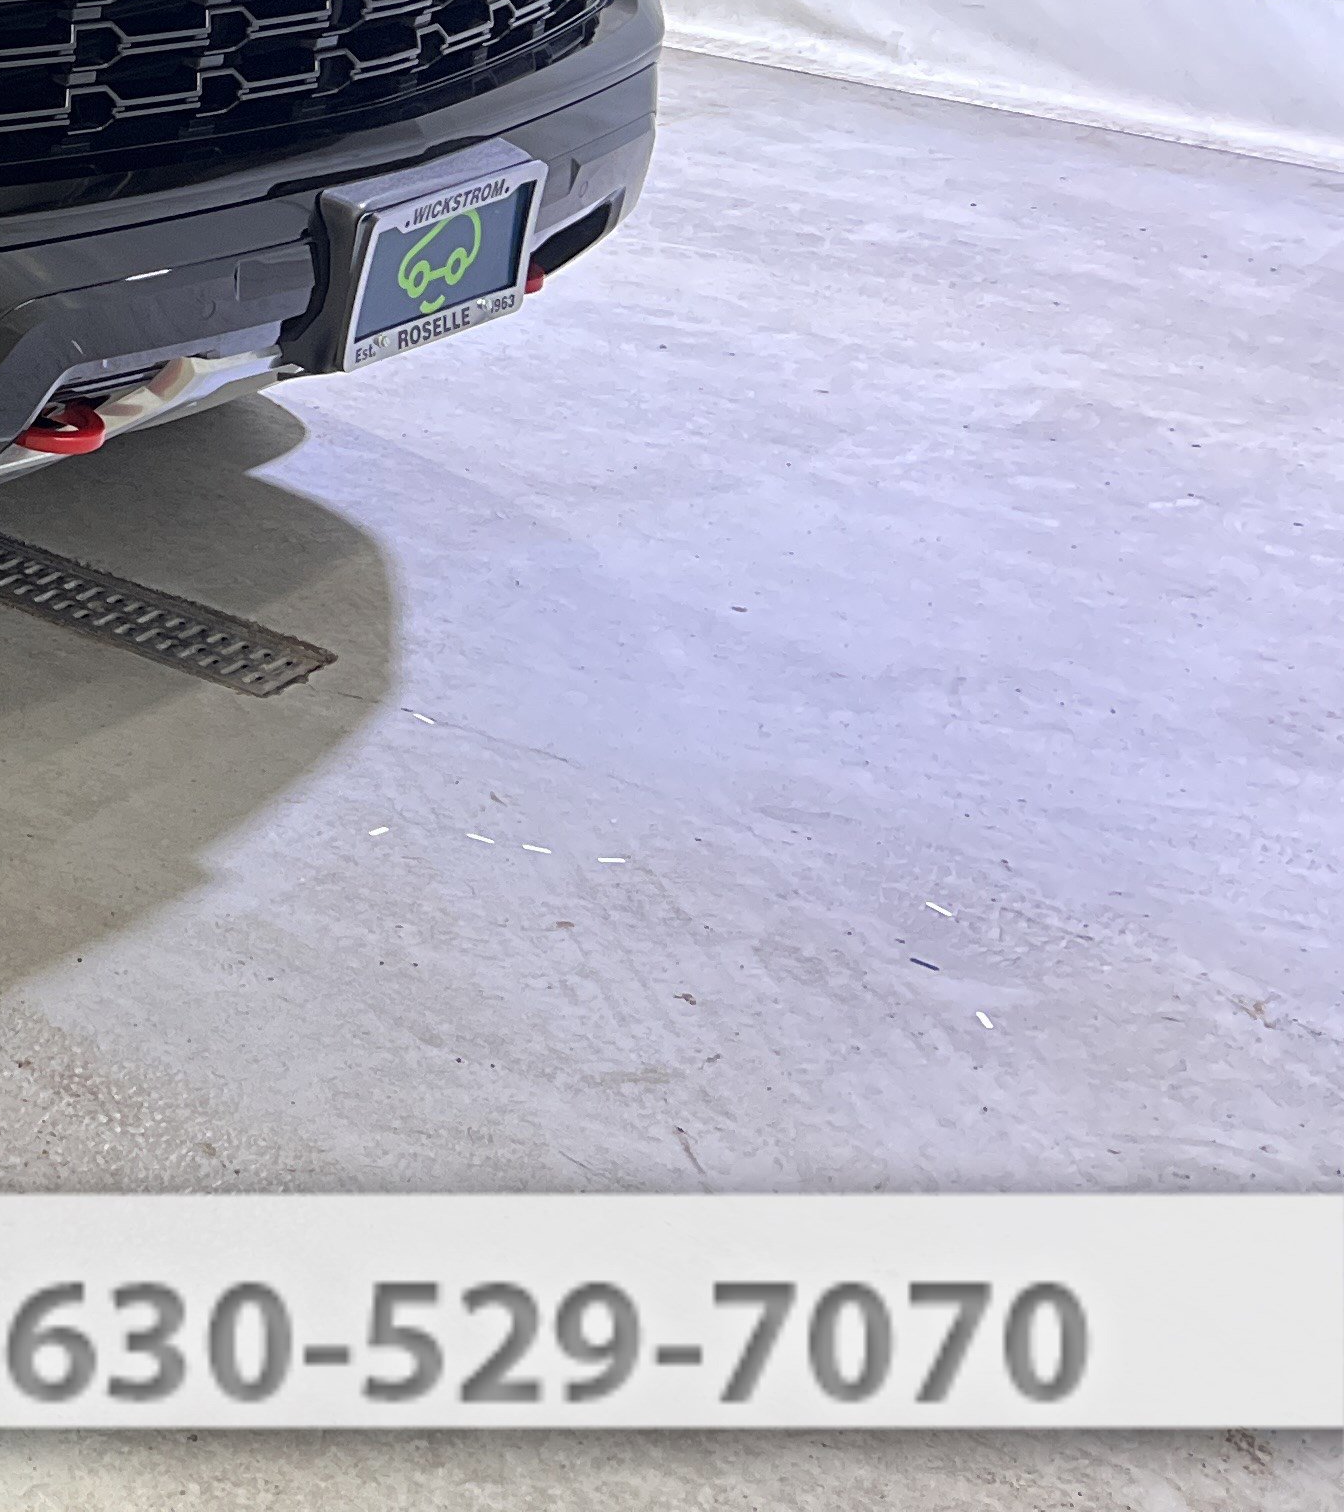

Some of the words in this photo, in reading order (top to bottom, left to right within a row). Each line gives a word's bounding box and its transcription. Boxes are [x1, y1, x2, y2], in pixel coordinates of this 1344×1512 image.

[413, 178, 506, 225] WICKSTROM
[355, 343, 376, 364] Est.
[397, 306, 471, 351] ROSELLE
